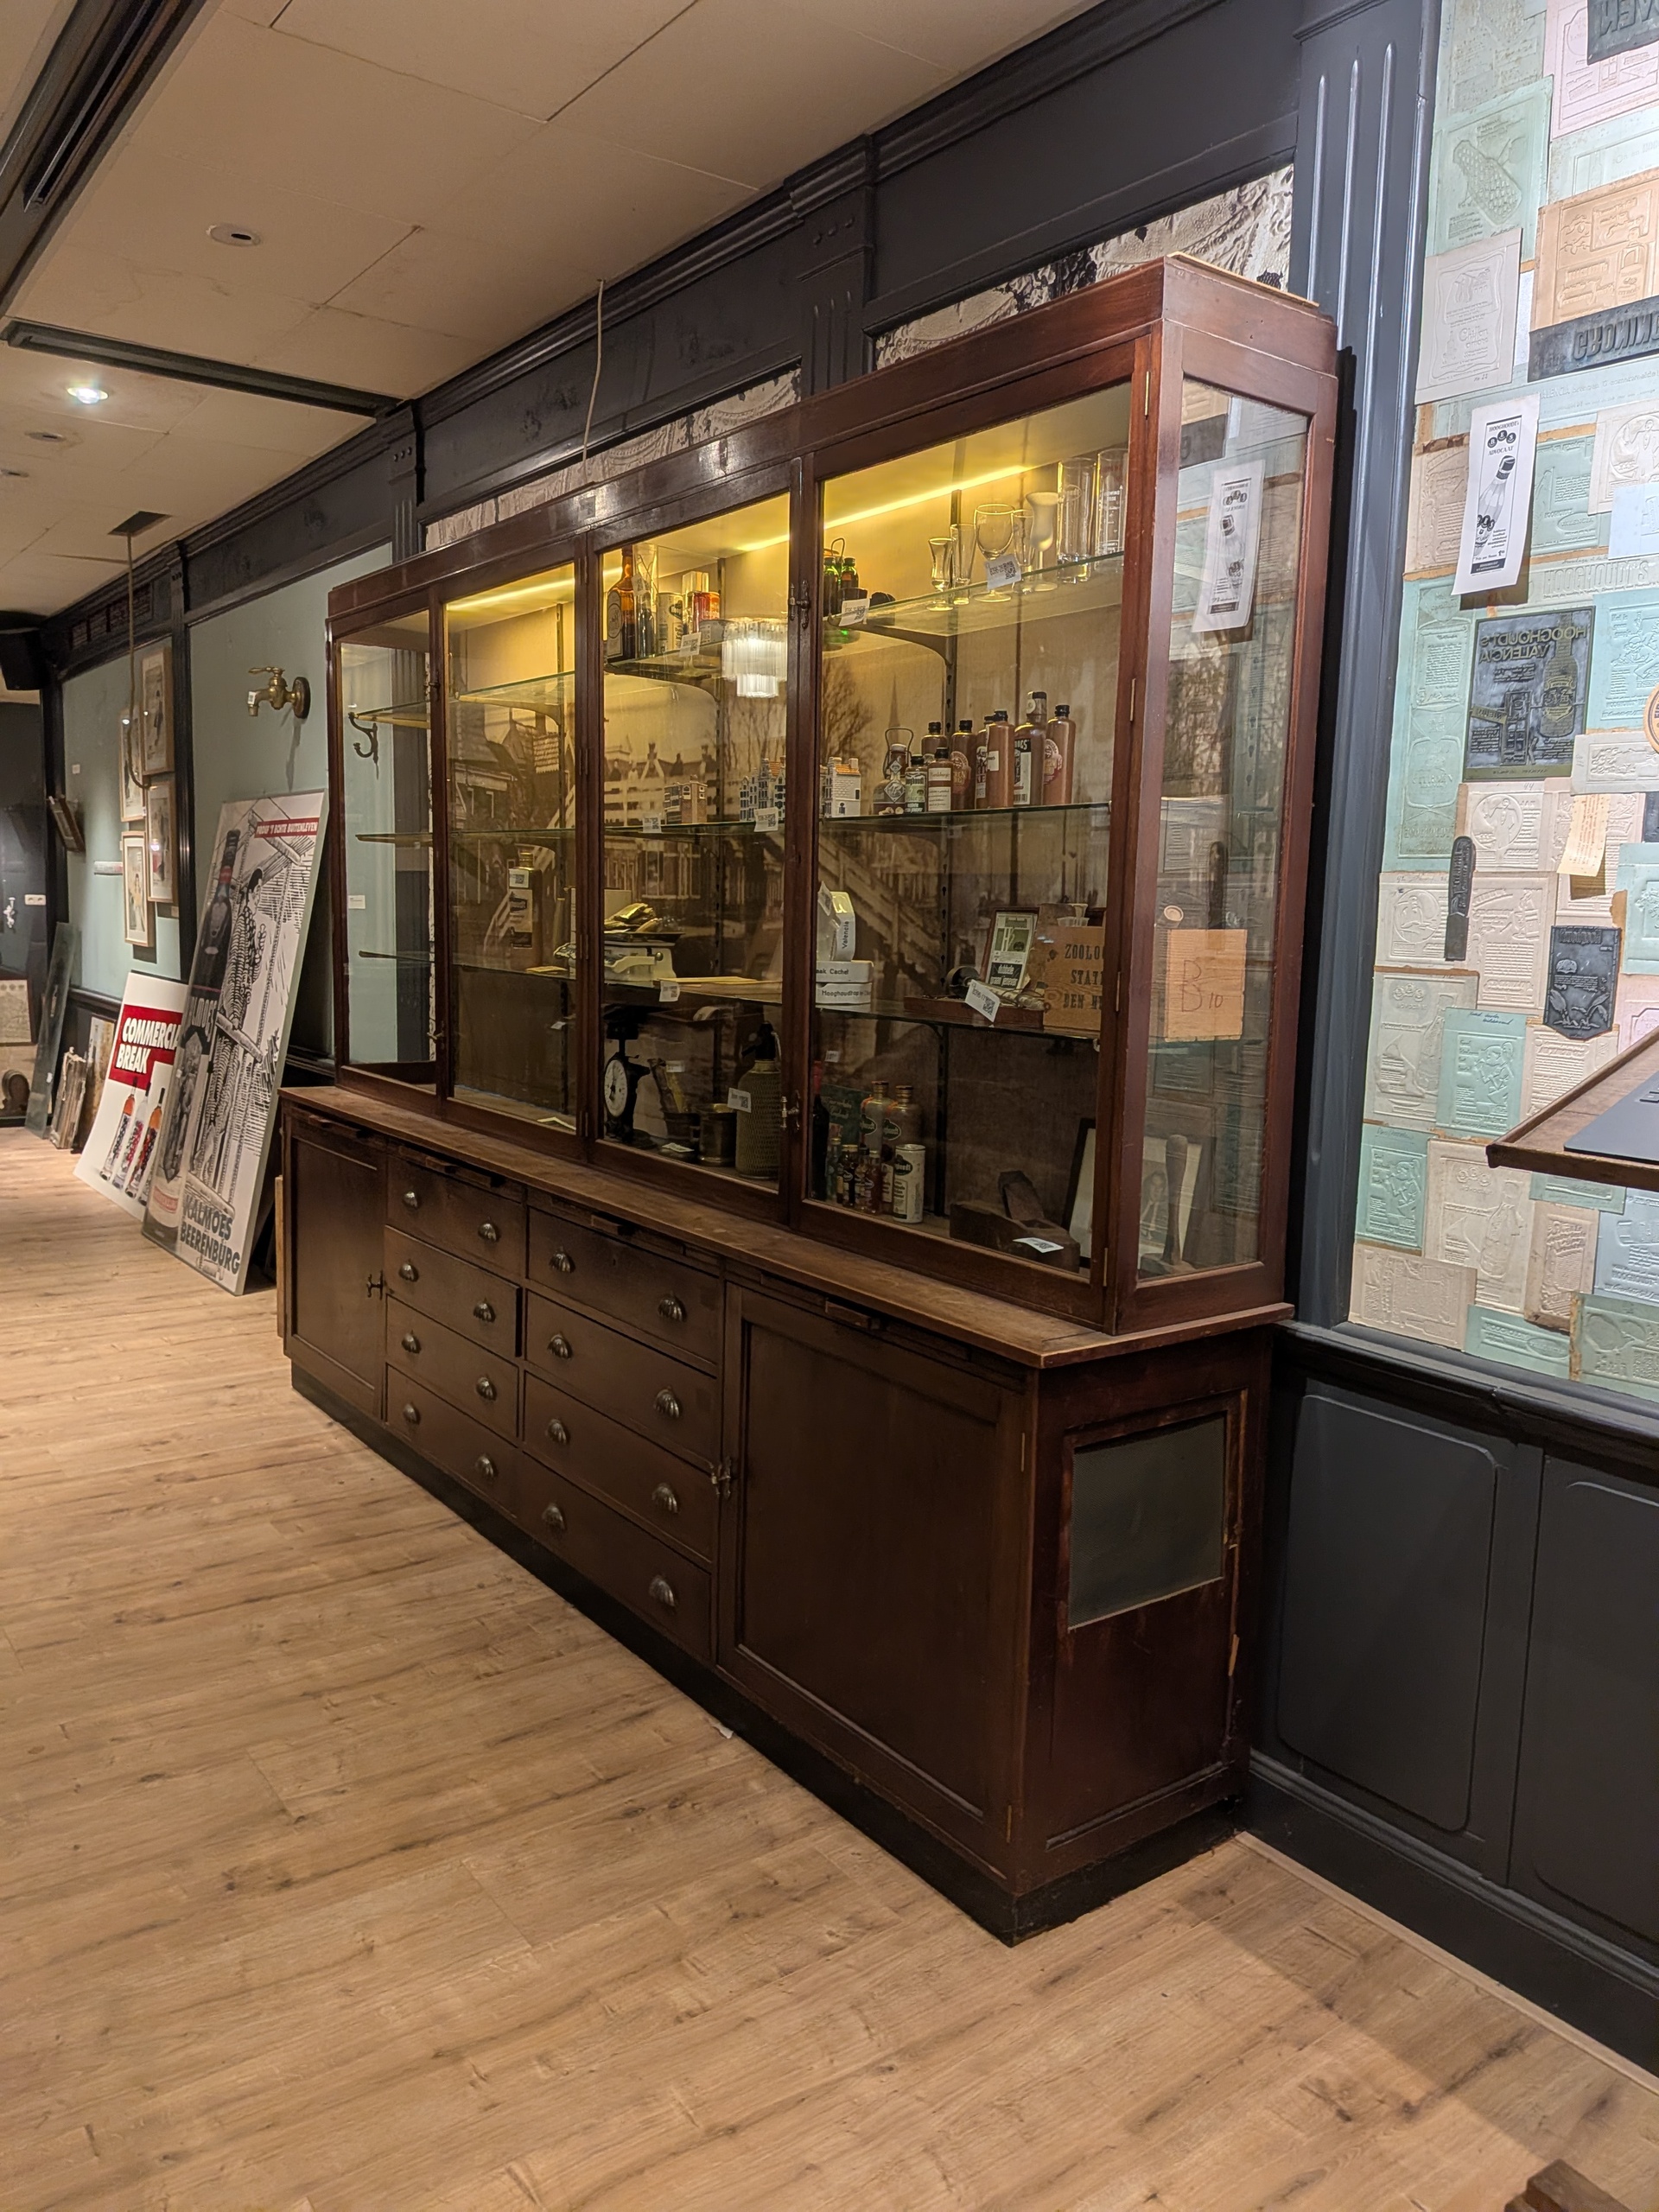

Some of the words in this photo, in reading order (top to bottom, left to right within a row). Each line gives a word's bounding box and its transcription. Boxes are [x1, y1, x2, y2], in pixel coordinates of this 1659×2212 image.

[1065, 944, 1103, 960] ZOOLO
[116, 1043, 151, 1074] BREAK
[182, 1194, 232, 1241] KALMOES
[180, 1221, 240, 1274] BEERENBURG
